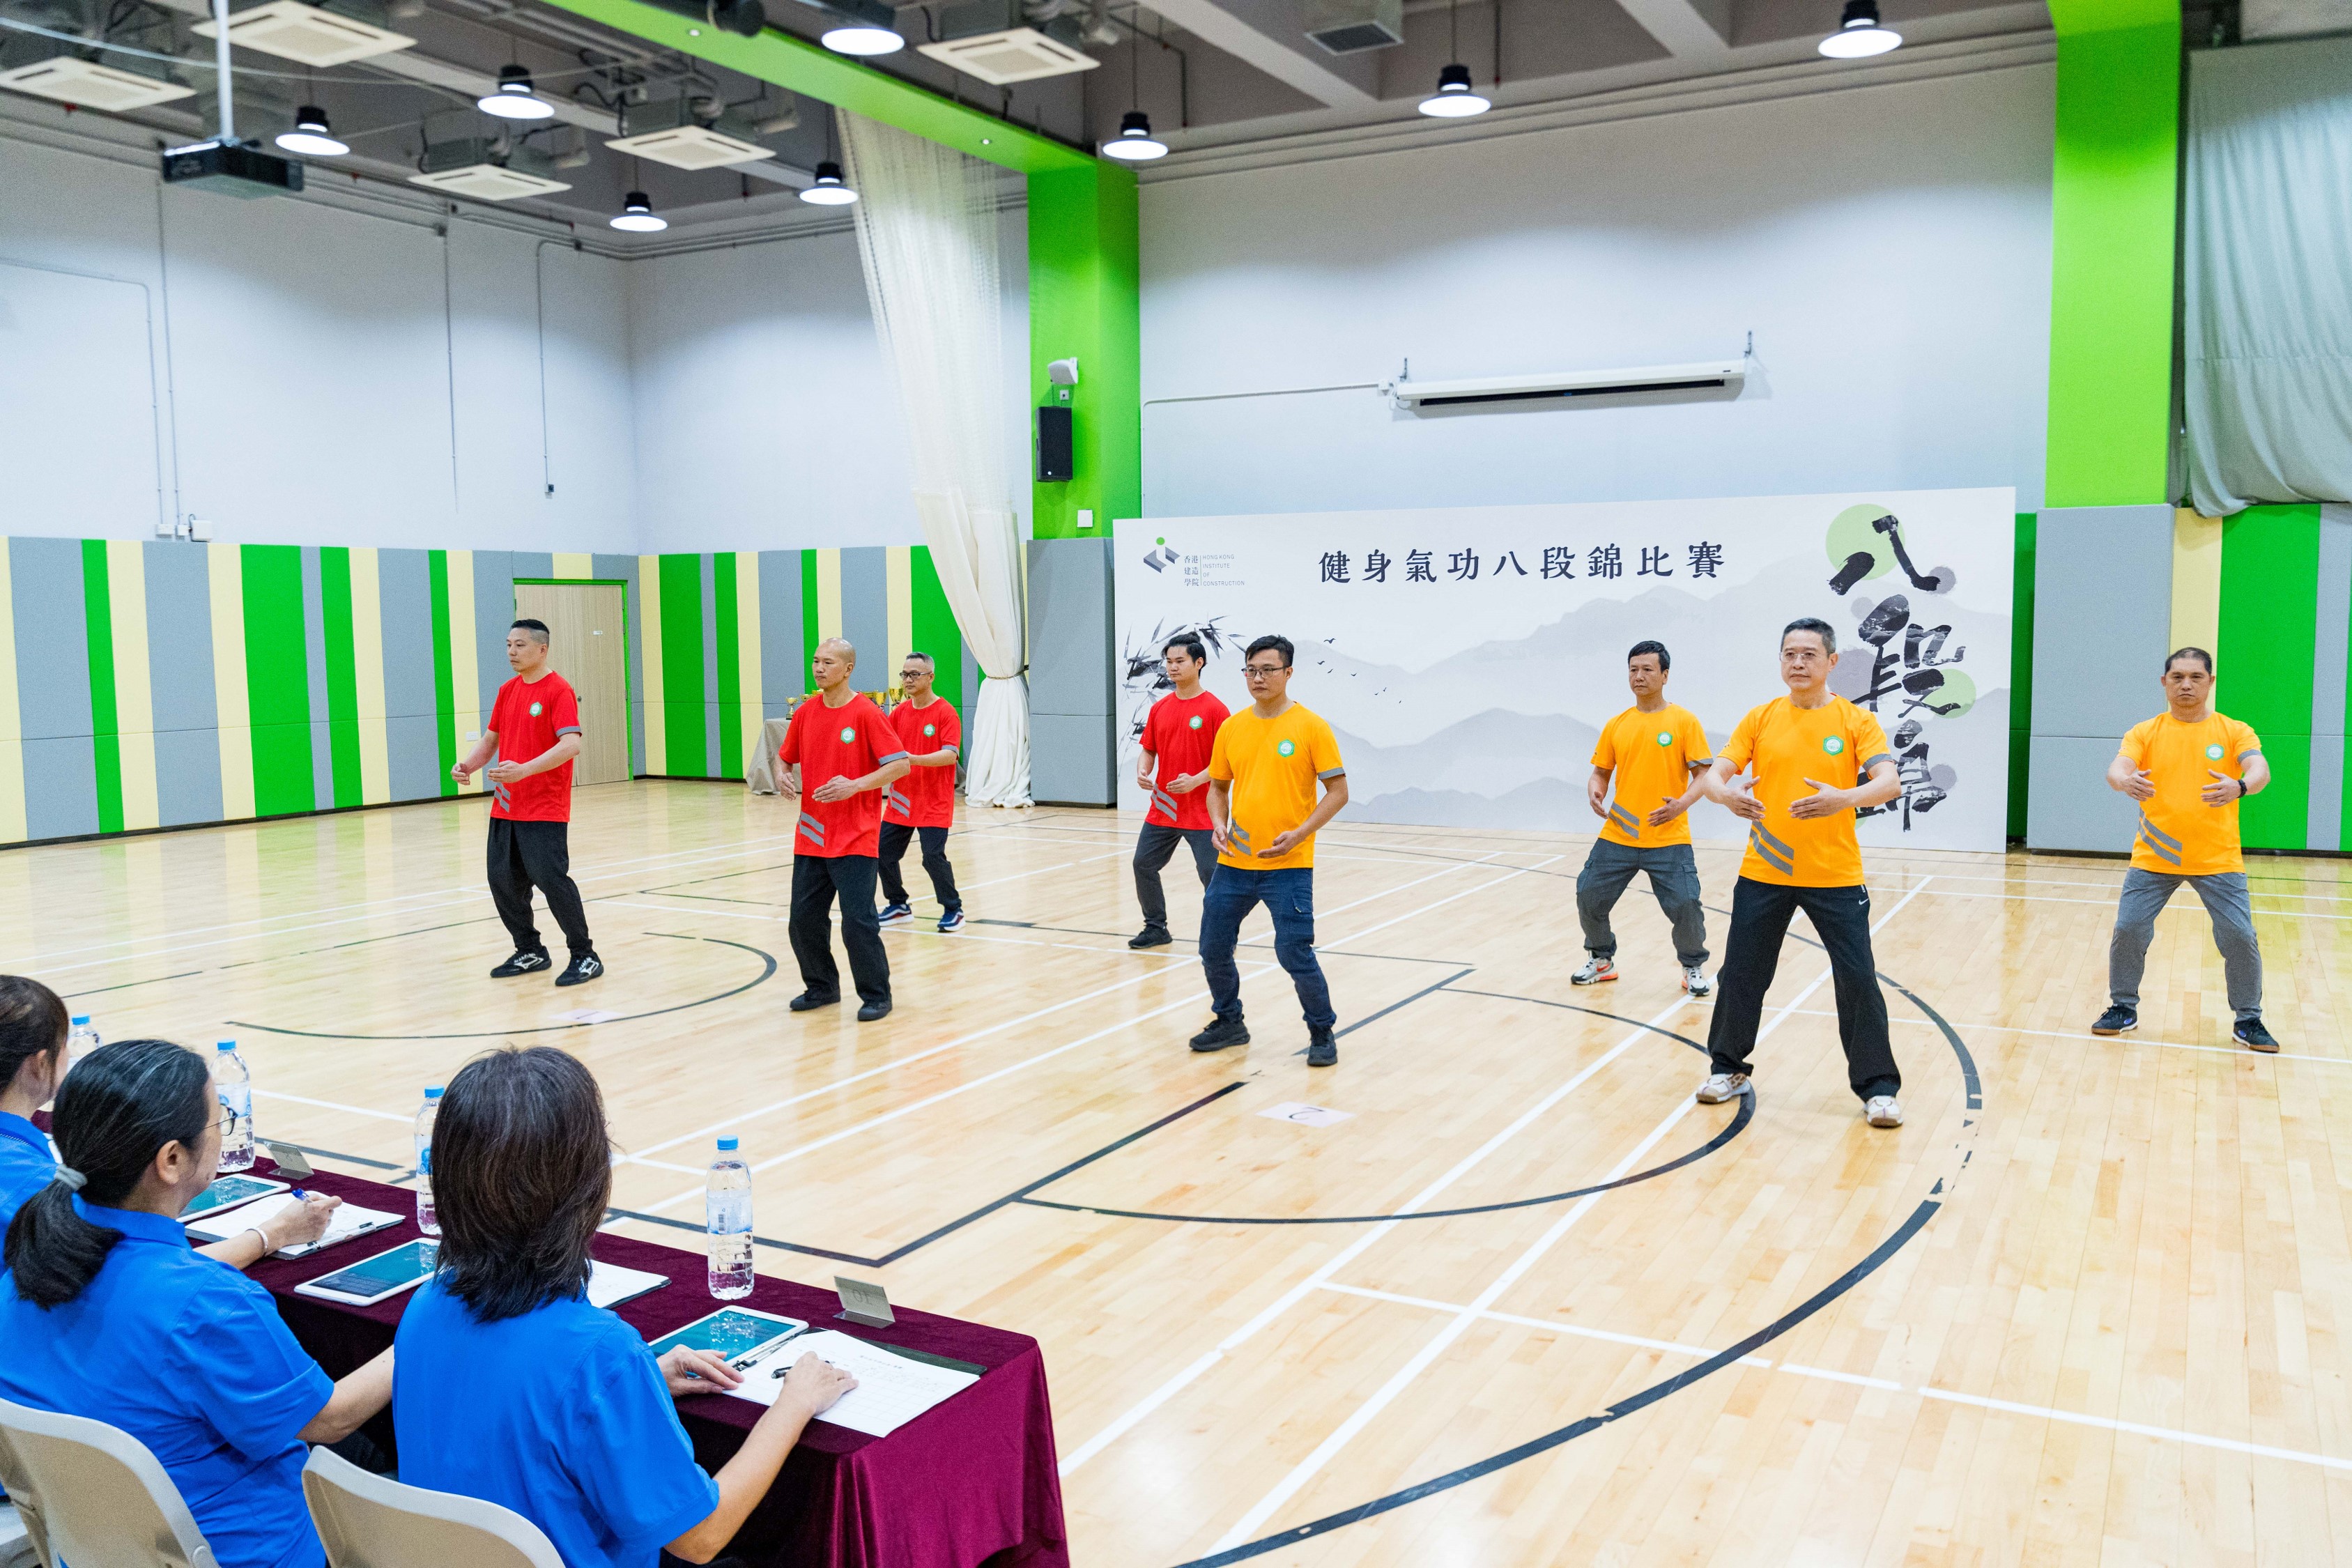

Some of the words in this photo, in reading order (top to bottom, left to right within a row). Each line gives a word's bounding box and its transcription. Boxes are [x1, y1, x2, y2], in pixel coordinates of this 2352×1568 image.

[1184, 555, 1199, 564] 香港
[1319, 541, 1725, 583] 健身氣功八段錦比賽
[1184, 578, 1199, 587] 學院
